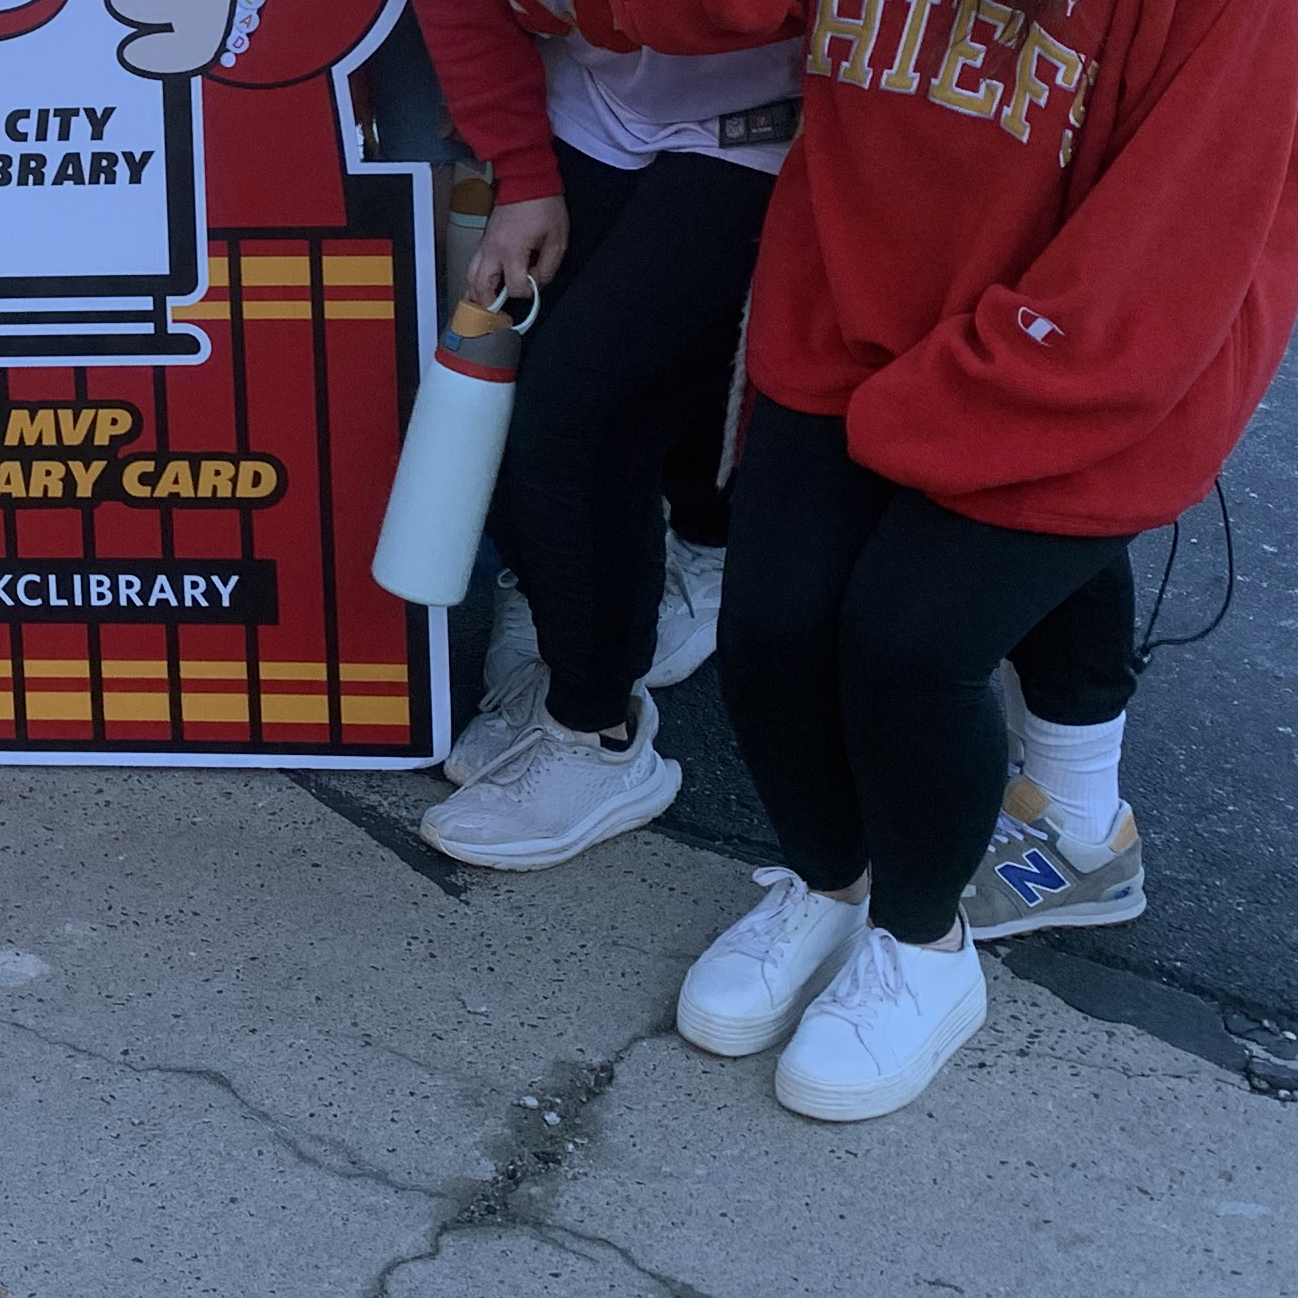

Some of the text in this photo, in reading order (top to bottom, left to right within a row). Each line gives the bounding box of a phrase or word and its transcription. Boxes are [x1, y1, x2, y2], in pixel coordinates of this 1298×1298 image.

[4, 106, 117, 142] CITY
[4, 408, 133, 446] MVP
[121, 460, 279, 499] CARD
